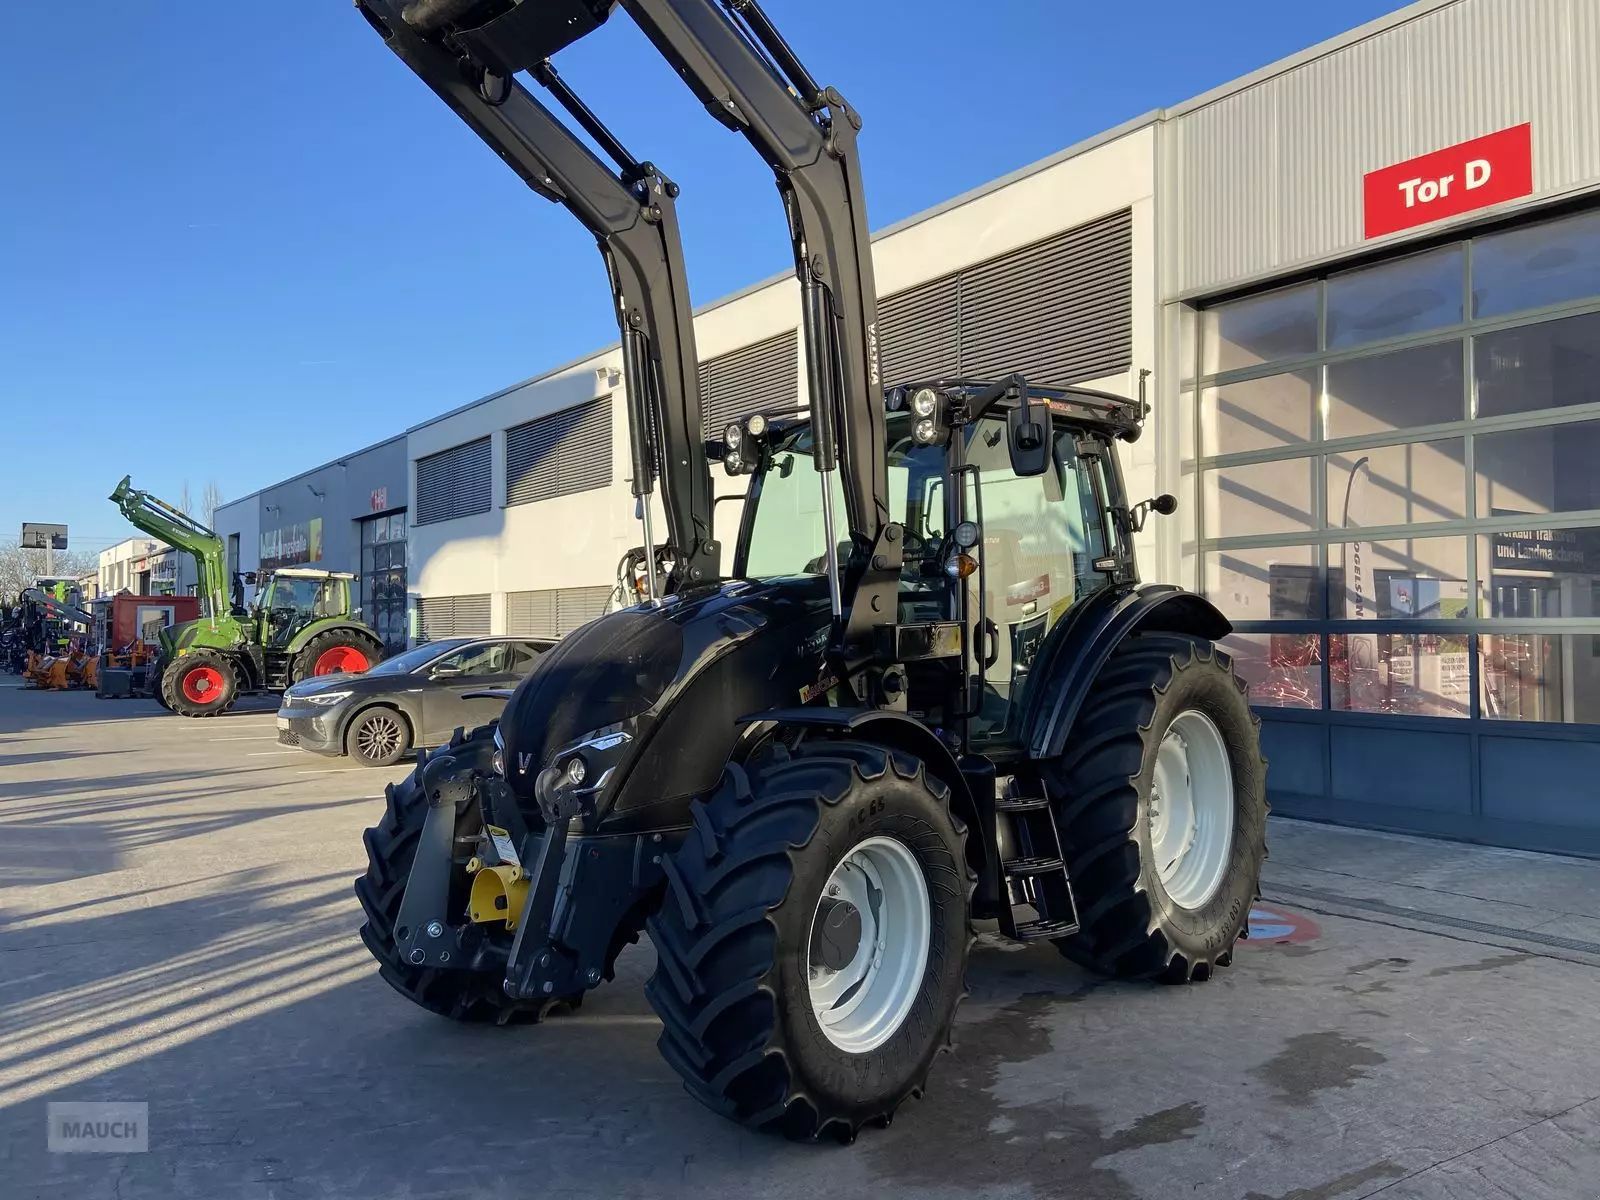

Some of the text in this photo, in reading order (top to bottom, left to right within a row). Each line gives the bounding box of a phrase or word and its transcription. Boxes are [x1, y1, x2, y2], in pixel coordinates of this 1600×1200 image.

[1398, 159, 1491, 208] Tor D
[868, 322, 879, 386] VALTRA
[1497, 543, 1516, 558] und
[1354, 541, 1364, 619] OGELSAN
